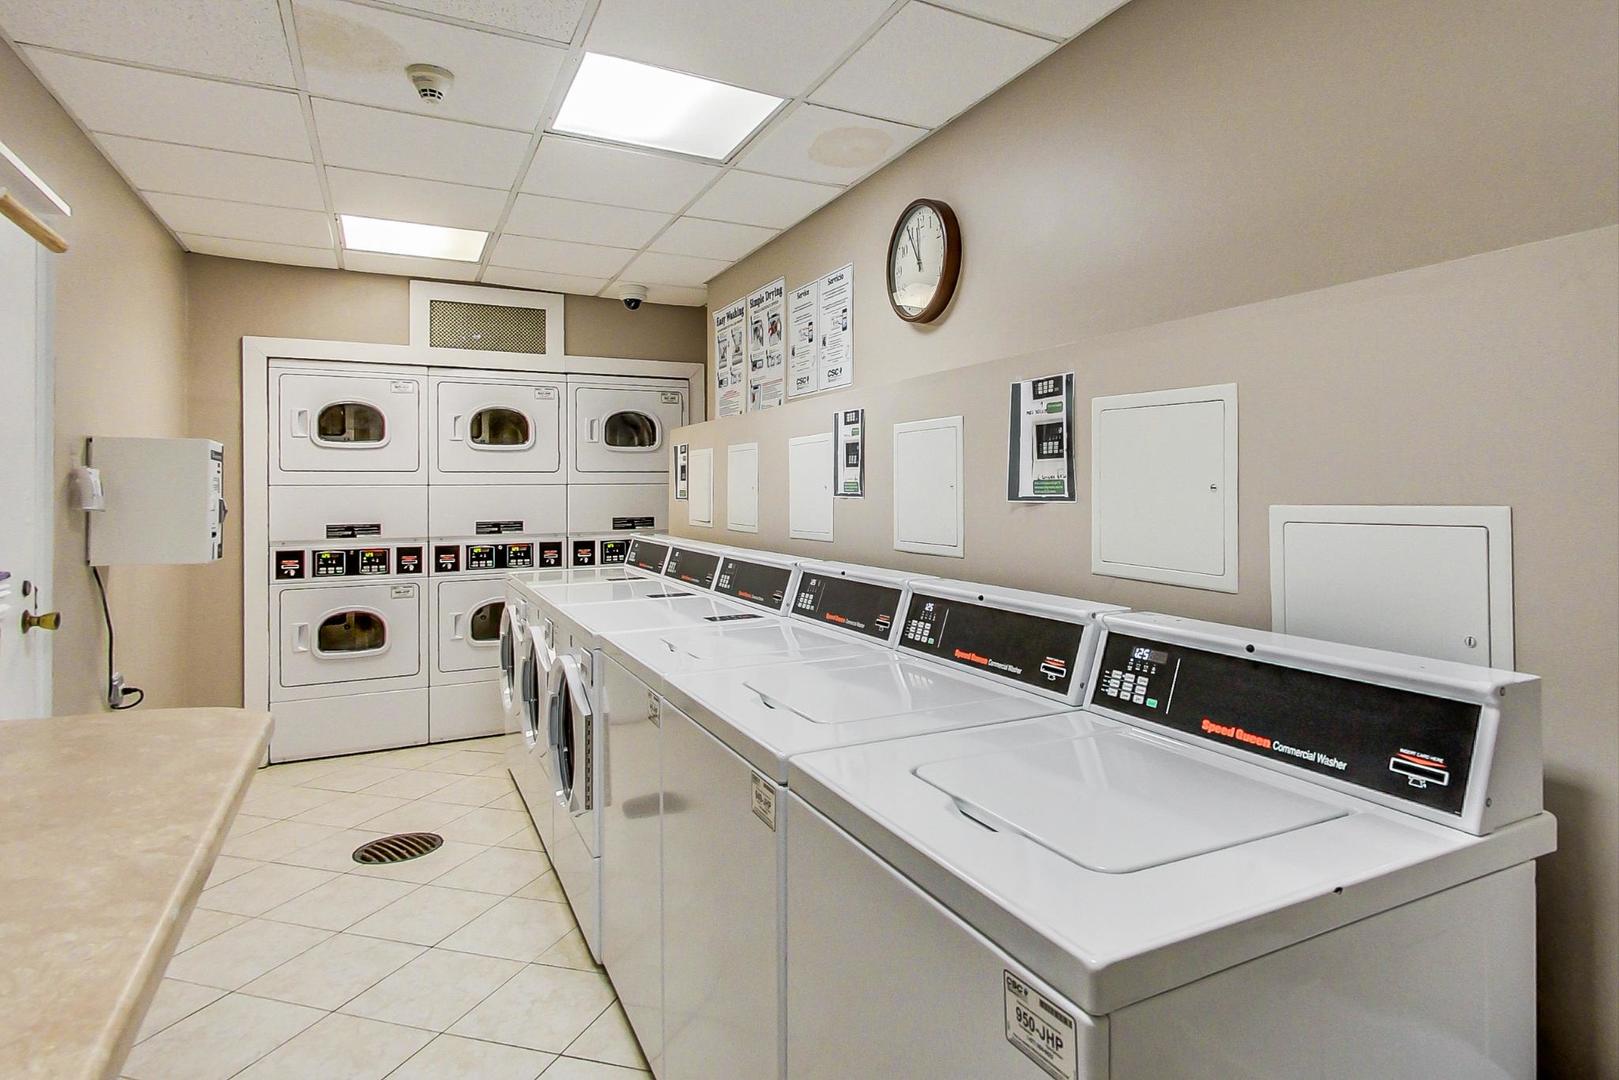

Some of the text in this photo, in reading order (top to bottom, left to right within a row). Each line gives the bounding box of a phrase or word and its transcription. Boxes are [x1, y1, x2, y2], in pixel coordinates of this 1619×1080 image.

[827, 273, 844, 286] Servicio
[749, 294, 765, 309] Simple
[765, 286, 783, 301] Drying
[716, 316, 726, 327] Easy
[726, 306, 744, 321] Washing
[796, 376, 807, 386] CSC
[827, 367, 839, 378] CSC
[1201, 719, 1348, 771] Speed Queen Commercial Washer
[1015, 1006, 1064, 1052] 950-JHP
